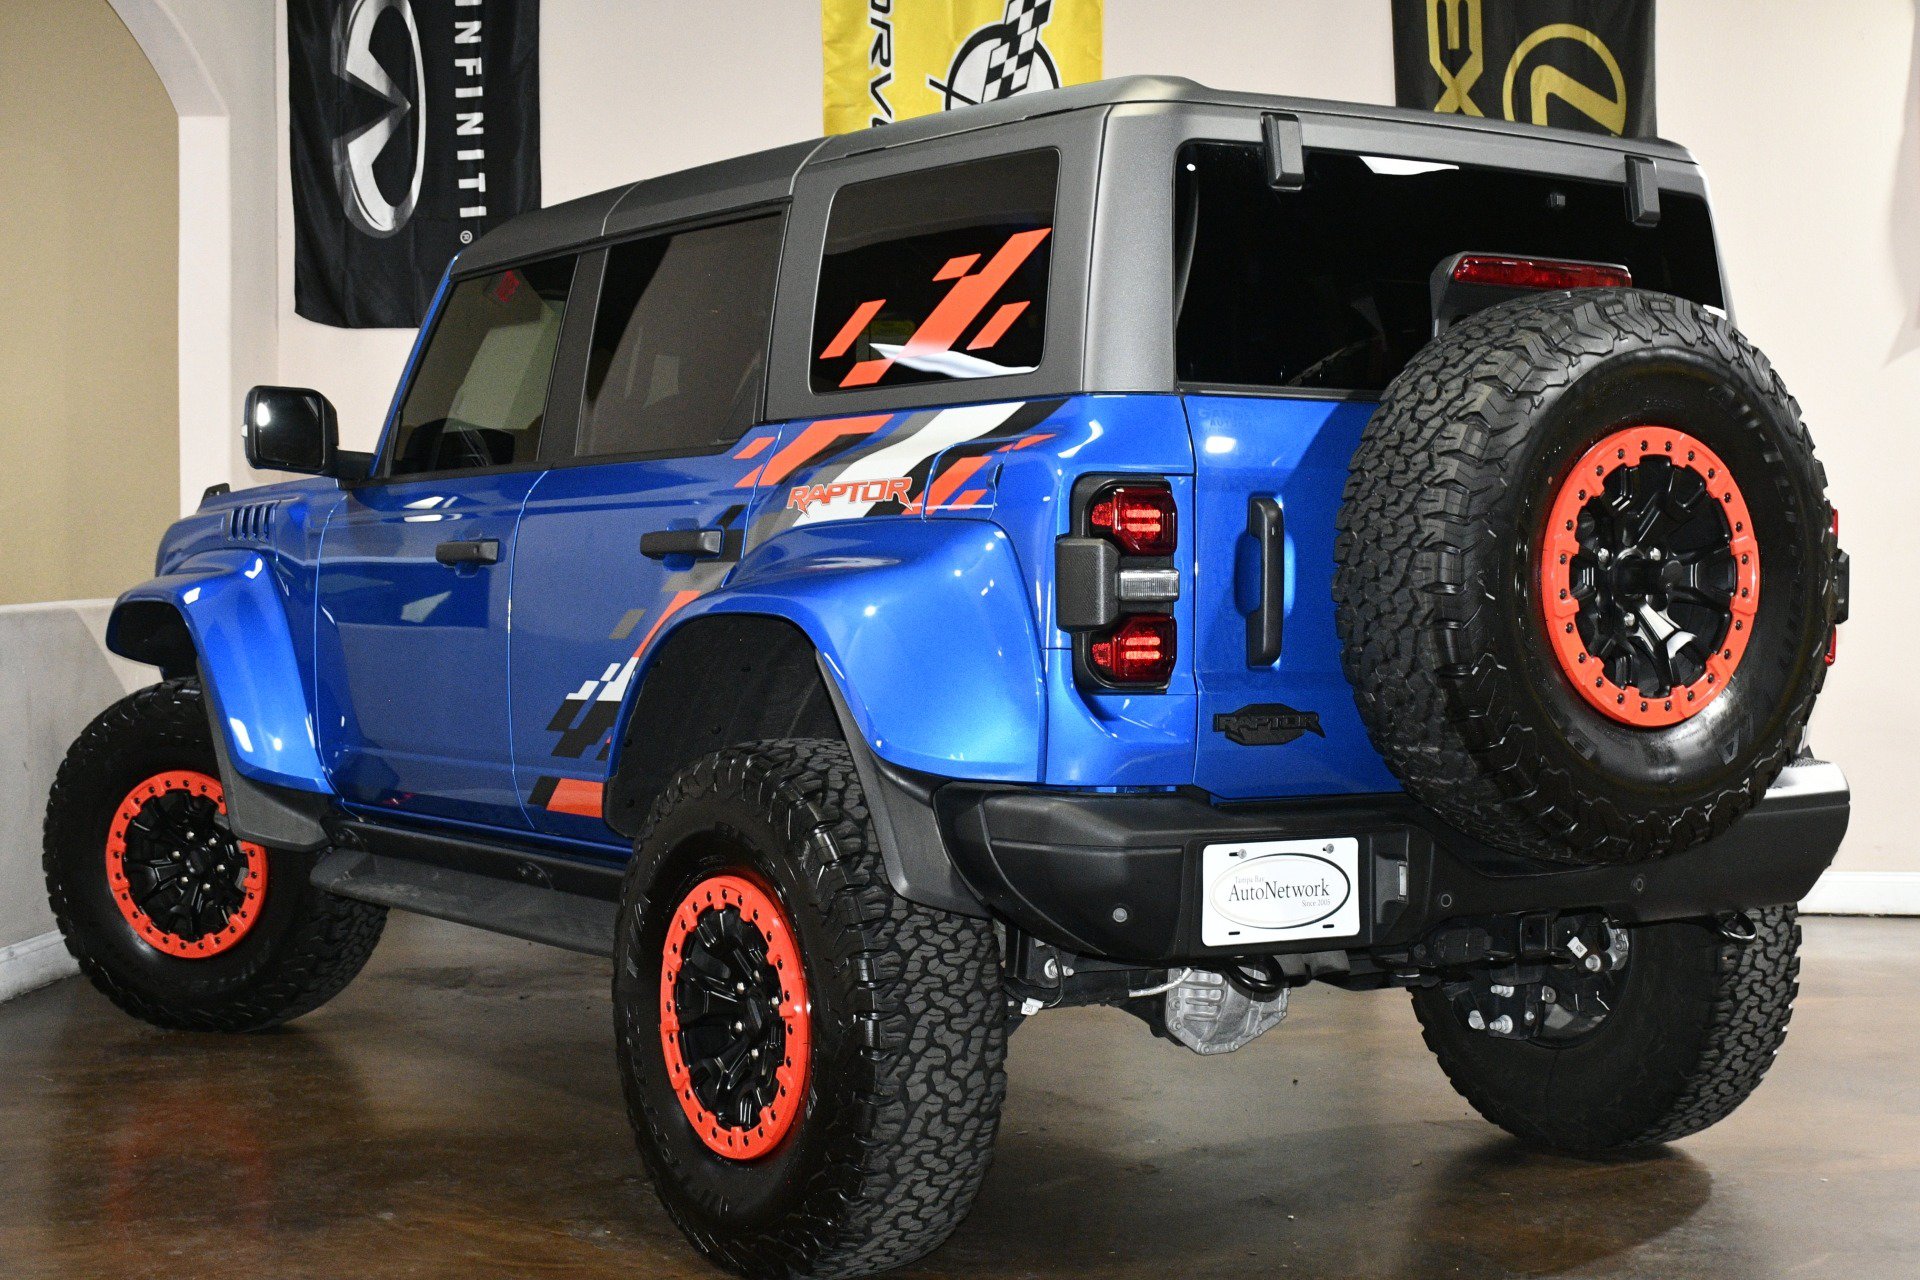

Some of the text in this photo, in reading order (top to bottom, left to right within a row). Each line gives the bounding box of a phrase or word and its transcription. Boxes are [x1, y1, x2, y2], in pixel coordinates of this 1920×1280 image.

[786, 476, 914, 518] RAPTOR
[1213, 711, 1326, 739] RAPTOR
[1228, 878, 1330, 902] AutoNetwork
